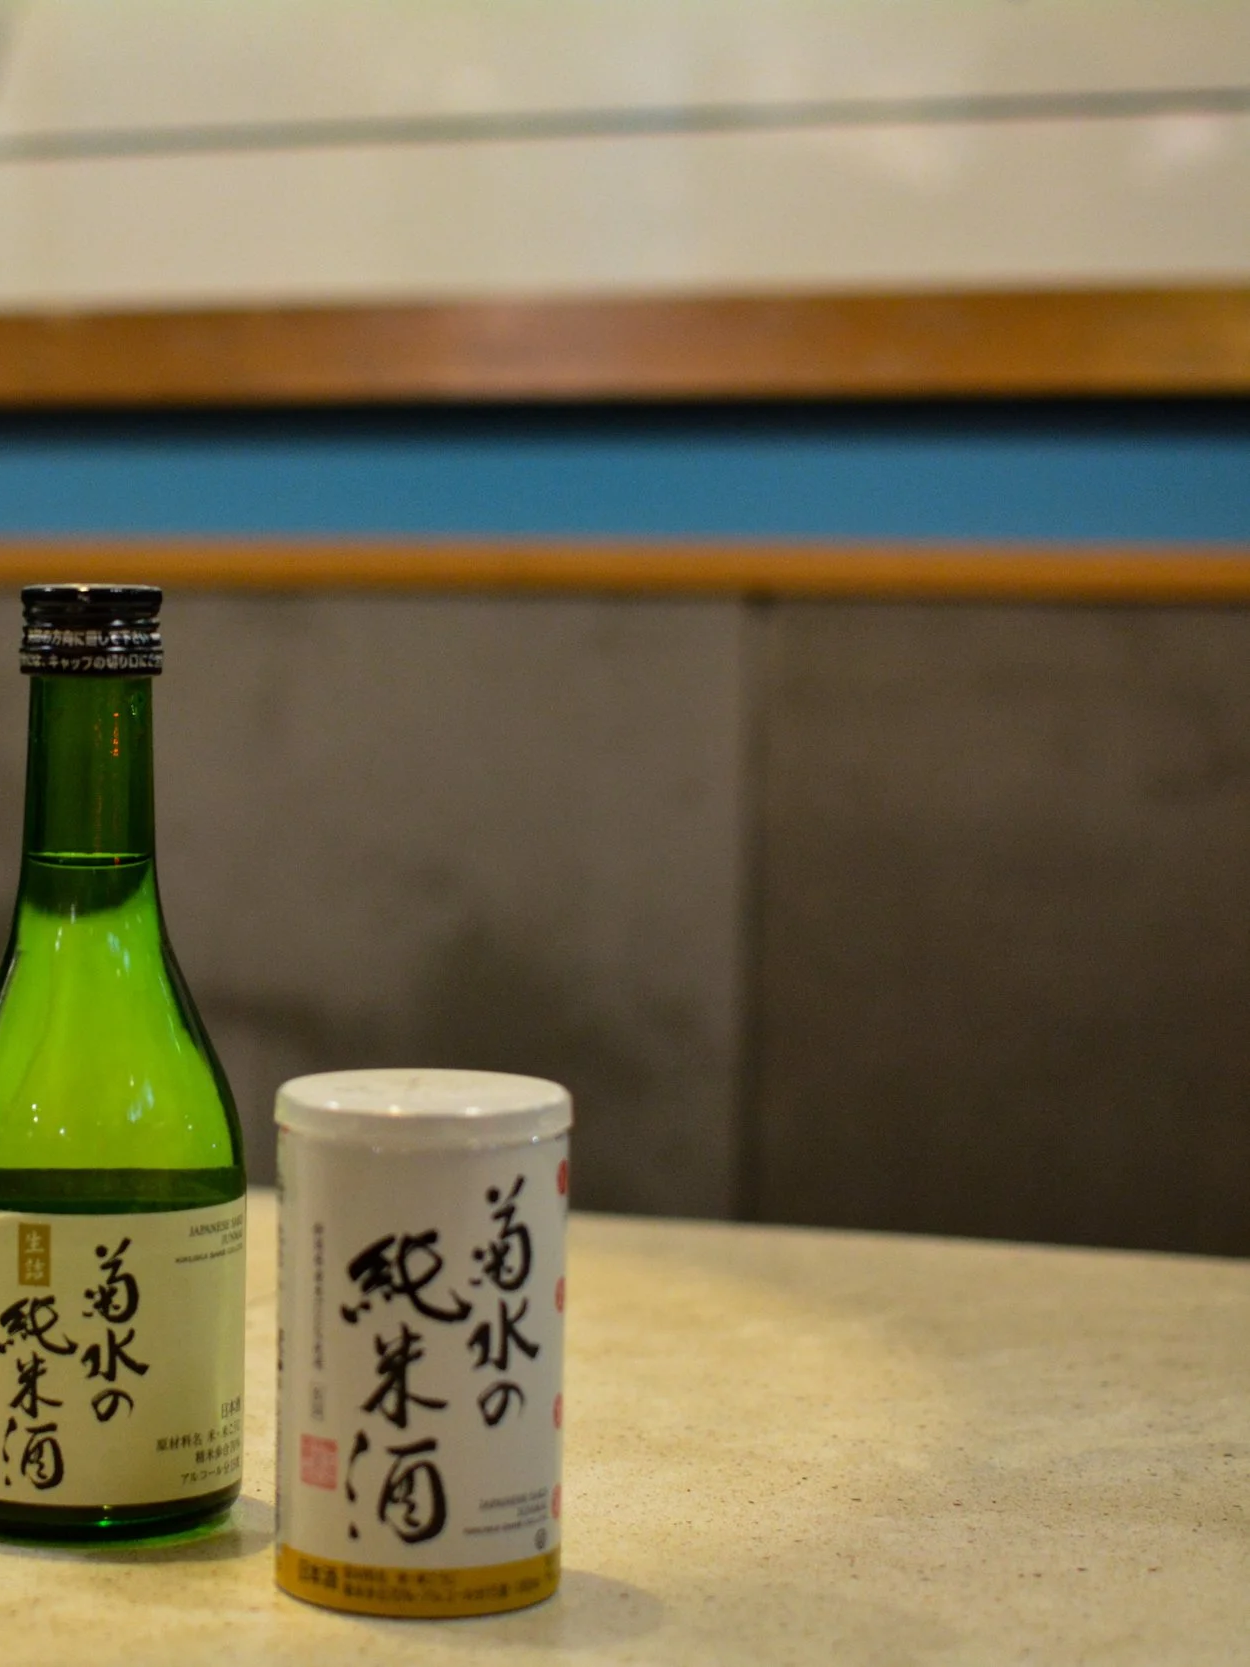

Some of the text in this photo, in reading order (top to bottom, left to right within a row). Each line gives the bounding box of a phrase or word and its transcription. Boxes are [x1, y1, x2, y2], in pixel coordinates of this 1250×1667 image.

[81, 1238, 149, 1422] 菊水の
[341, 1229, 471, 1543] 純米酒
[467, 1175, 539, 1426] 菊水の
